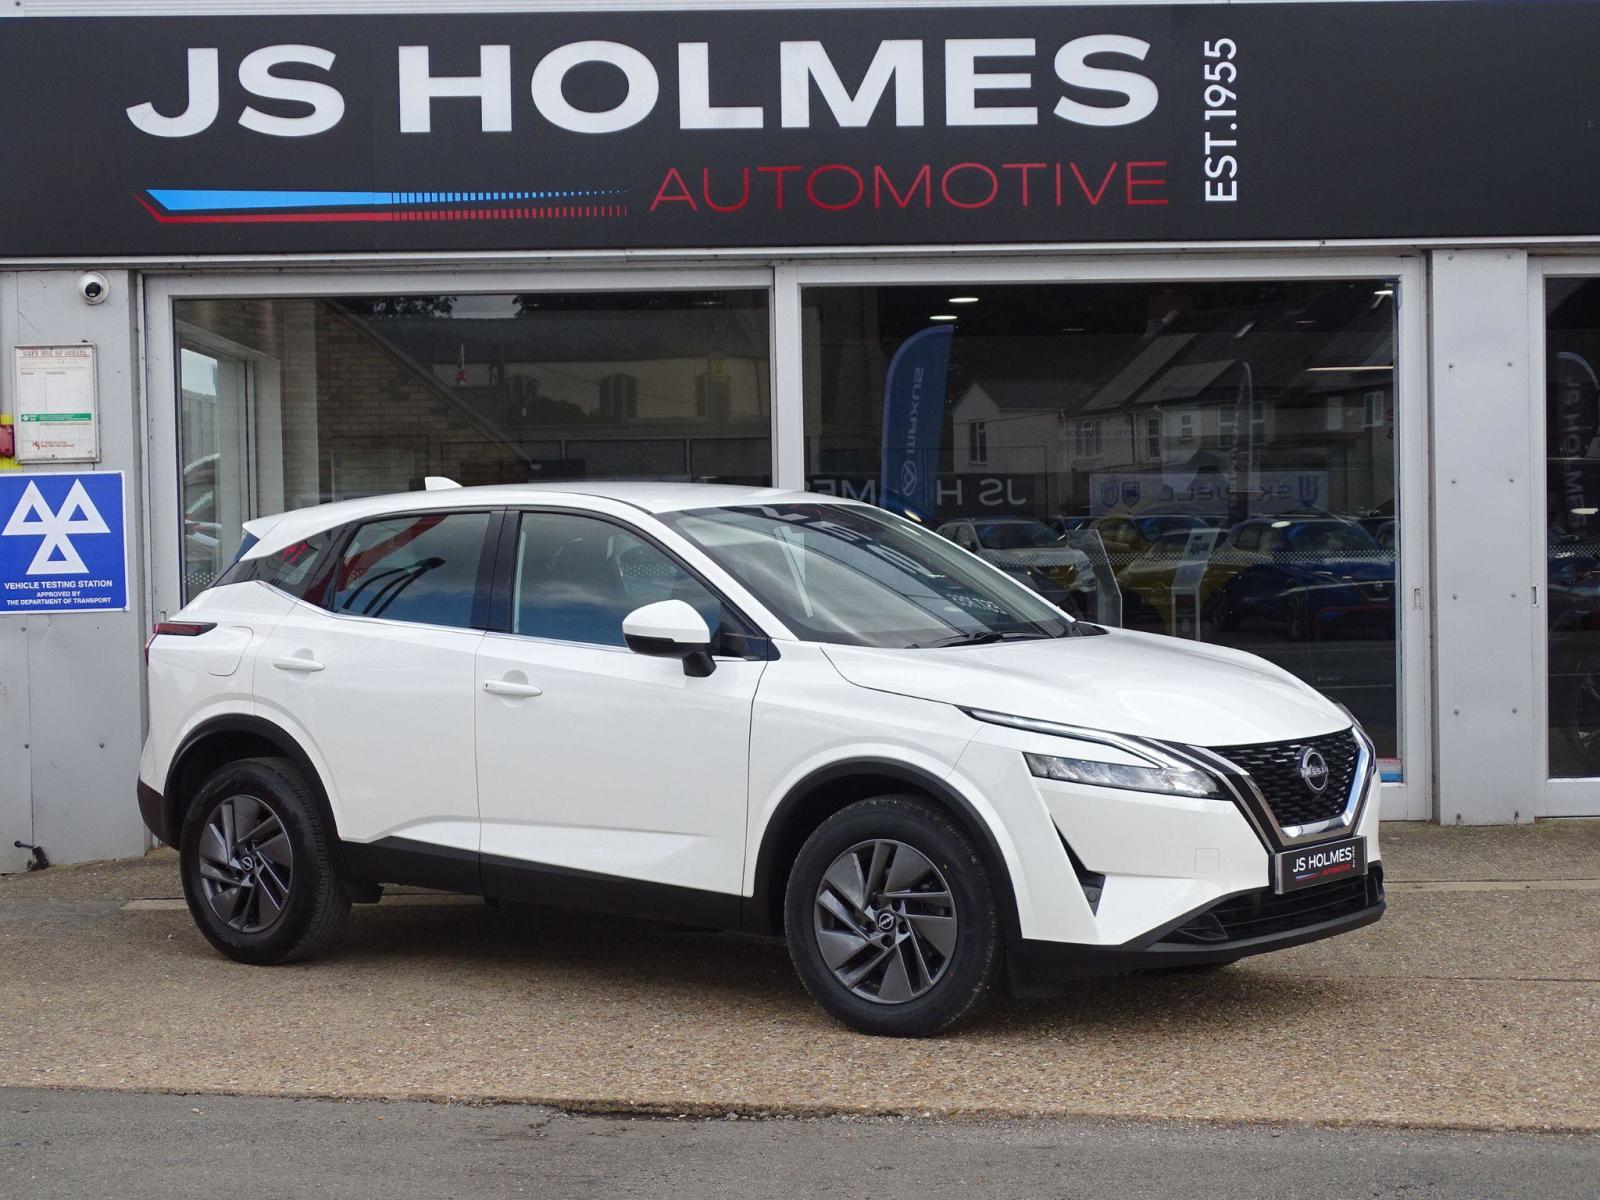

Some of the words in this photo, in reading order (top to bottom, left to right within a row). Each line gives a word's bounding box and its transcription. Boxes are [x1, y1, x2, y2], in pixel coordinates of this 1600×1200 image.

[126, 44, 346, 138] JS
[398, 34, 1160, 135] HOLMES
[1204, 37, 1238, 202] EST.1955
[650, 161, 1169, 213] AUTOMOTIVE
[4, 581, 40, 590] VEHICLE
[41, 580, 77, 589] TESTING
[77, 579, 113, 588] STATION
[1292, 856, 1307, 873] JS
[1308, 846, 1352, 869] HOLMES
